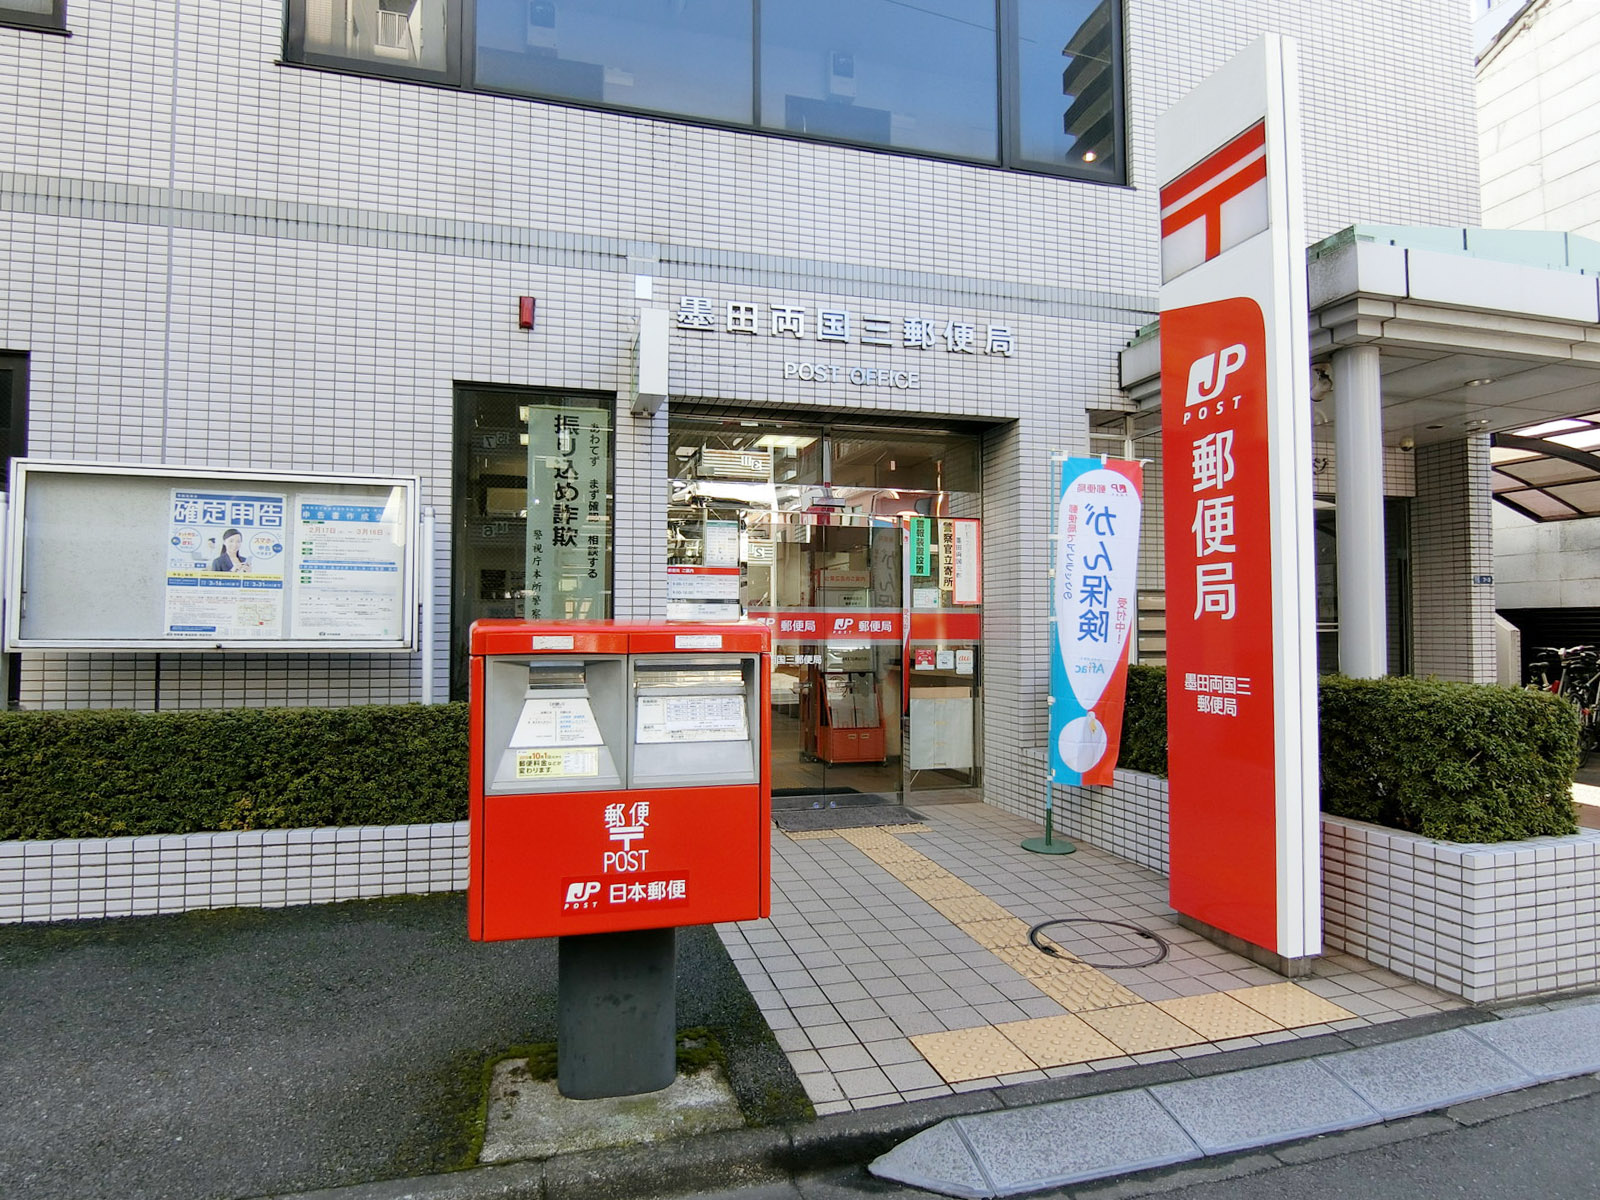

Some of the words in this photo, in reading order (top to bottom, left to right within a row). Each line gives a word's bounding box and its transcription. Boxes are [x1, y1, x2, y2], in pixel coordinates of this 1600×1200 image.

[677, 295, 1016, 358] 墨田両国三郵便局
[783, 361, 840, 383] POST
[849, 366, 920, 390] OFFICE
[1182, 394, 1242, 426] POST
[552, 413, 580, 548] 振り込め詐欺
[174, 500, 283, 527] 確定申告
[1191, 428, 1237, 621] 郵便局
[588, 535, 599, 579] 相談する
[780, 619, 816, 633] 郵便局
[858, 620, 892, 633] 郵便局
[1184, 672, 1252, 696] 墨田両国三
[1197, 694, 1238, 718] 郵便局
[604, 801, 651, 829] 郵便
[603, 849, 650, 874] POST
[609, 879, 687, 904] 日本郵便
[563, 901, 598, 910] POST
